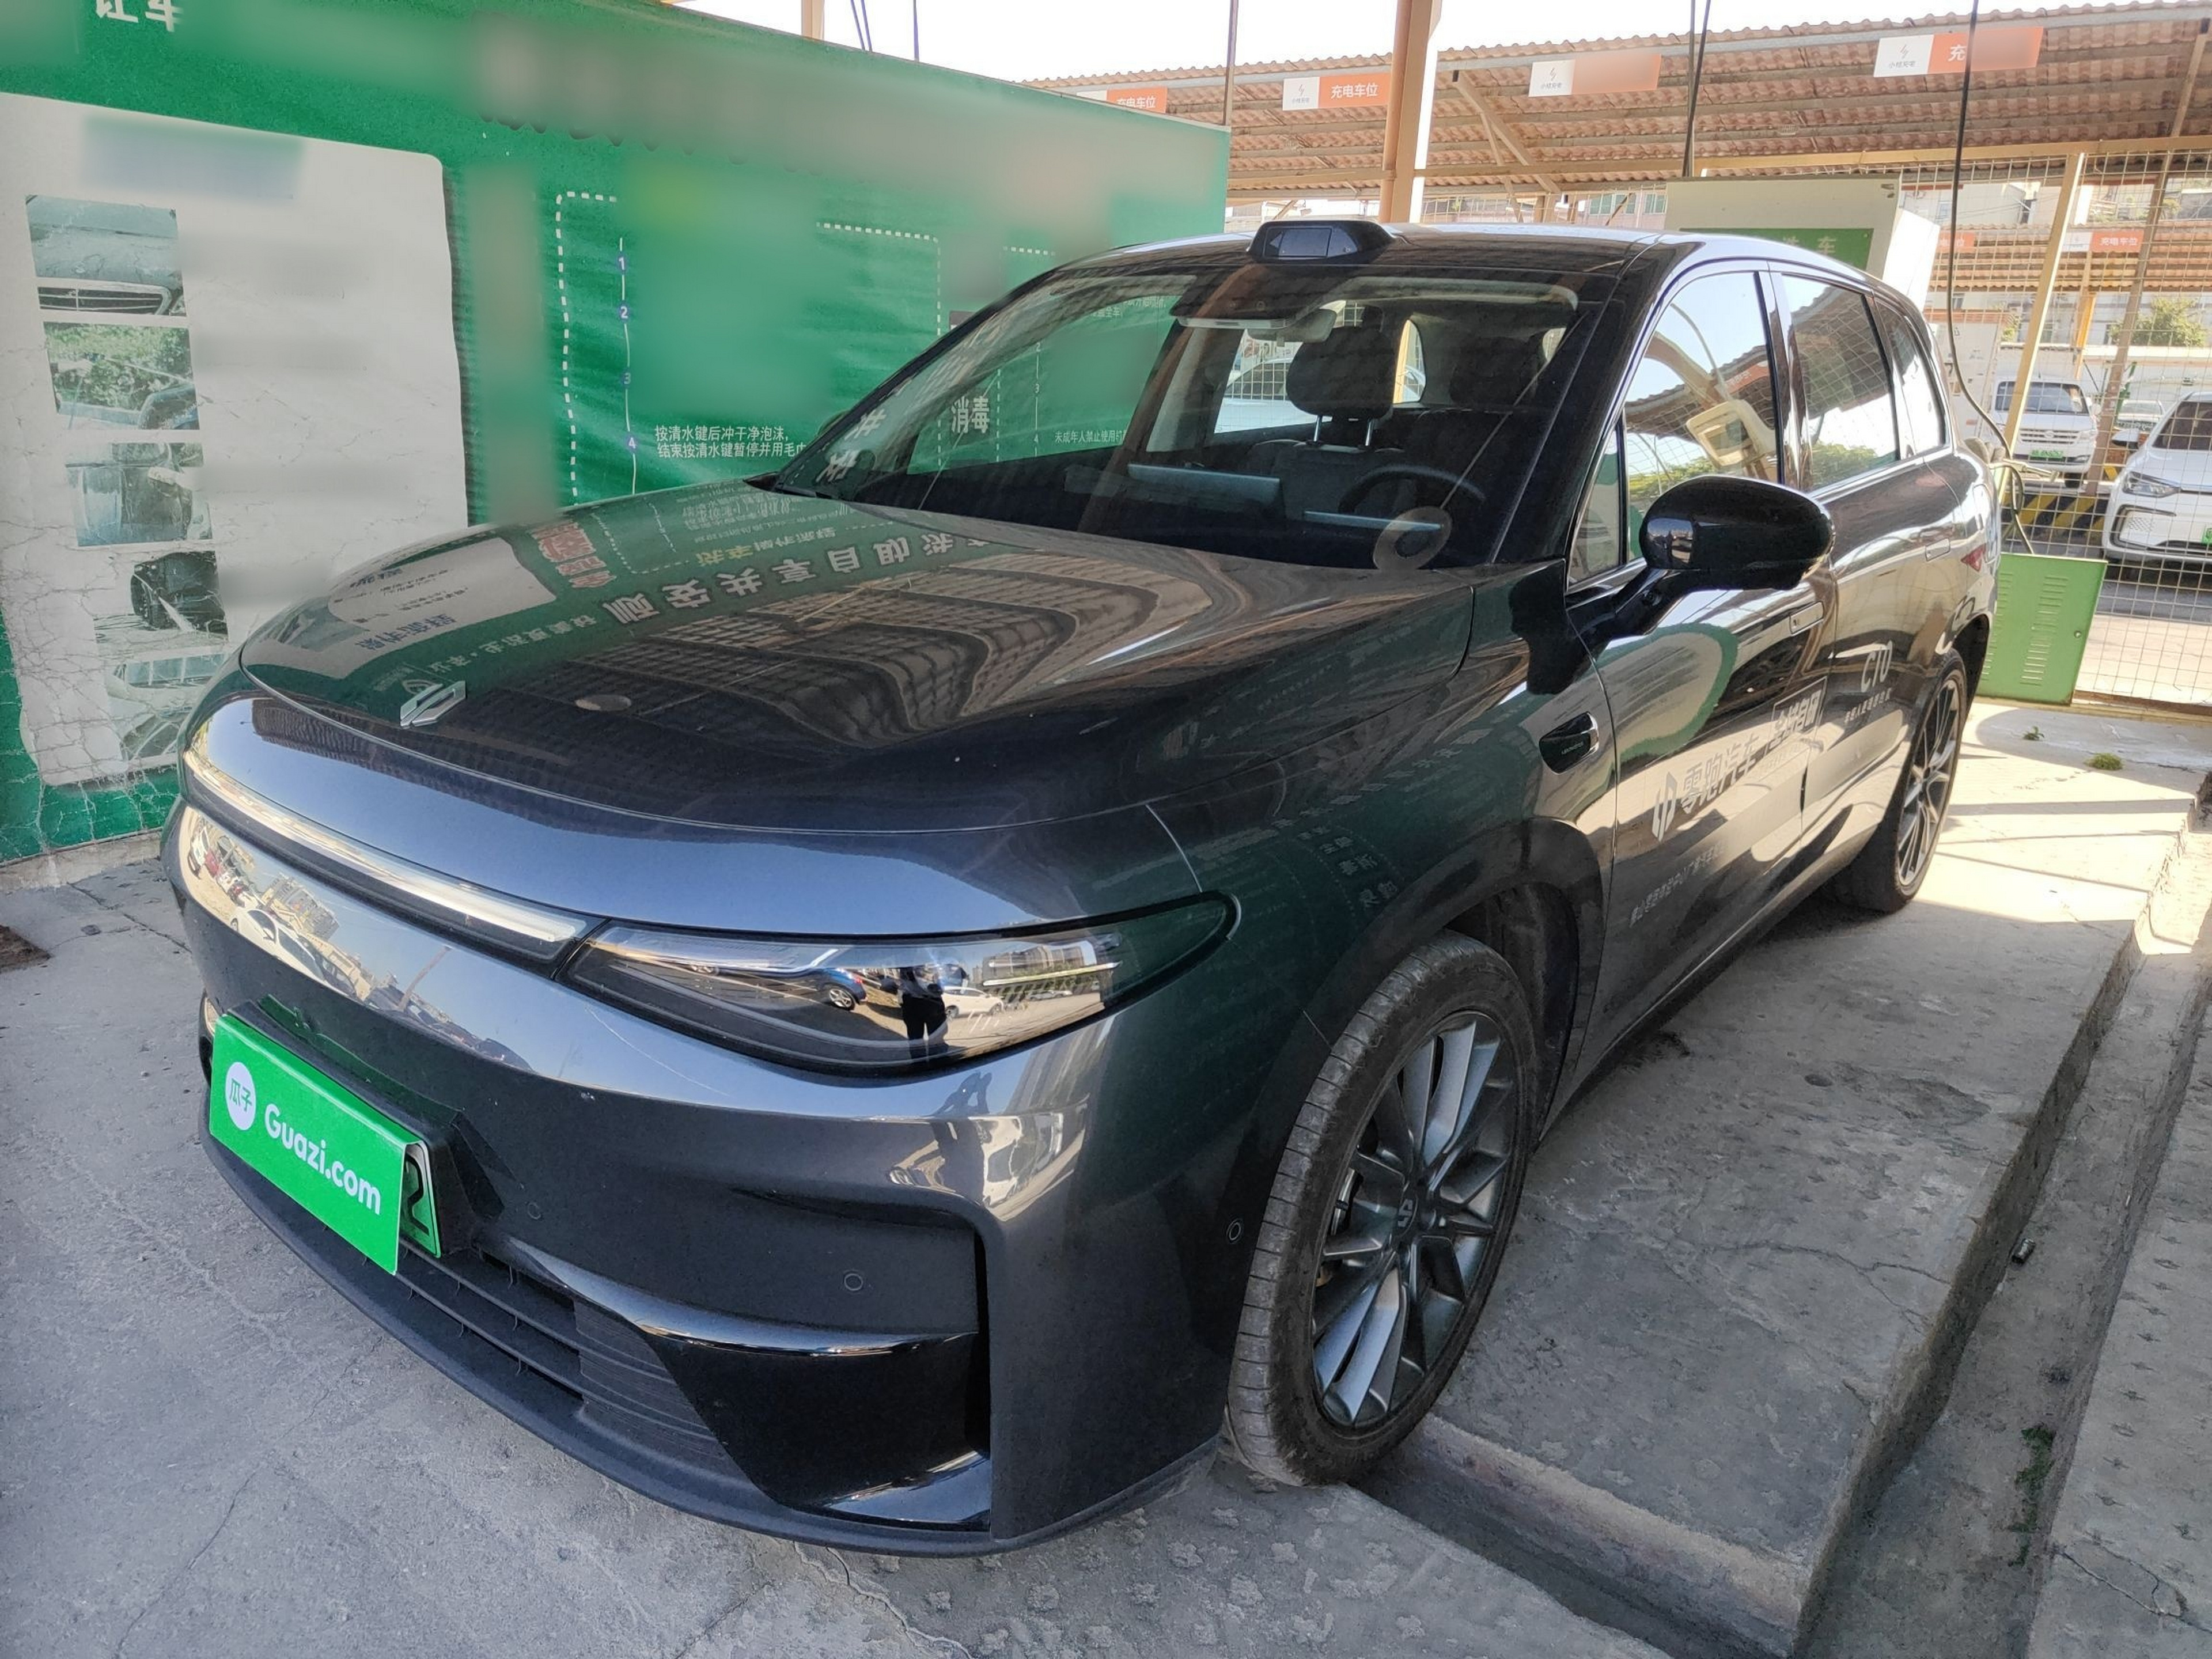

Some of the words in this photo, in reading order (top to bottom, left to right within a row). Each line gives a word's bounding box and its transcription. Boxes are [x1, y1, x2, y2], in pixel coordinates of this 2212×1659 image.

[1331, 83, 1378, 99] 充电车位
[618, 257, 626, 270] 1
[620, 306, 628, 319] 2
[624, 372, 631, 384] 3
[951, 396, 990, 434] 消毒
[628, 437, 636, 449] 4
[230, 1078, 252, 1112] 瓜子
[265, 1104, 381, 1214] Guazi.com
